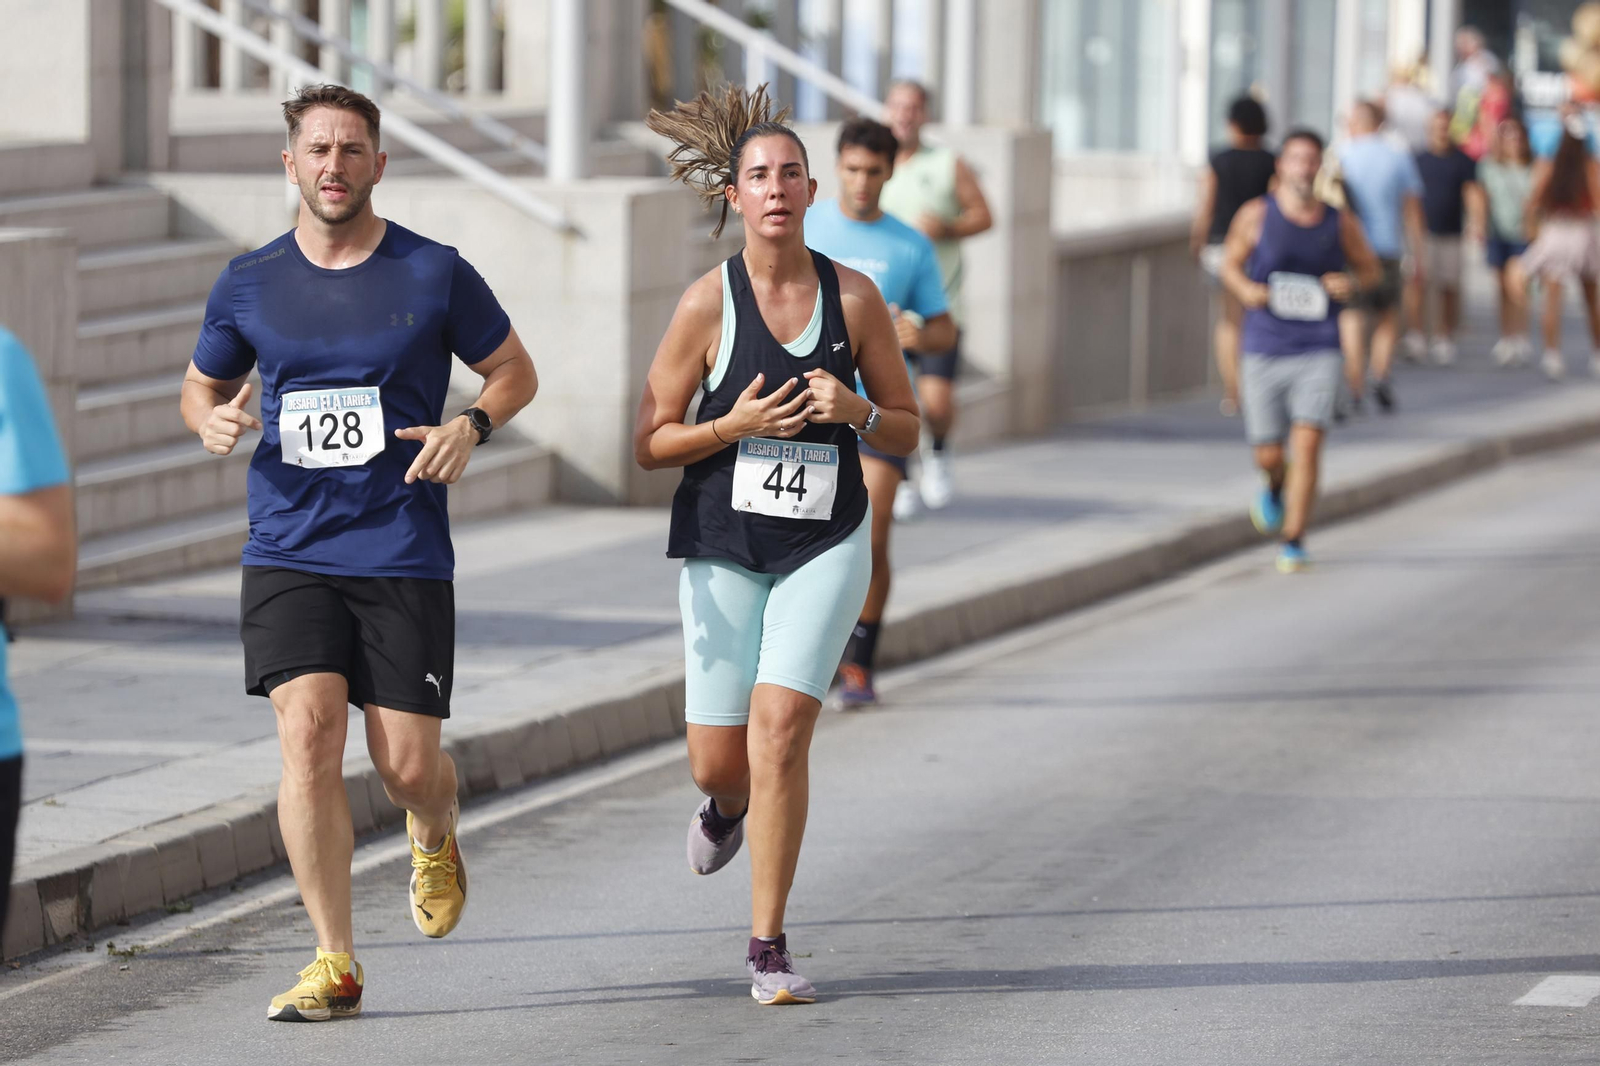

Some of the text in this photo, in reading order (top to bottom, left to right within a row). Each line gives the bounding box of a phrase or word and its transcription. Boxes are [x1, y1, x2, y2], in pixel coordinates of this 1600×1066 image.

[234, 247, 286, 271] UNDER ARMOUR
[320, 393, 342, 412] ELA
[341, 394, 372, 408] TARIFA
[298, 411, 364, 452] 128
[781, 444, 803, 462] ELA
[804, 449, 830, 462] TARIFA
[762, 462, 808, 502] 44
